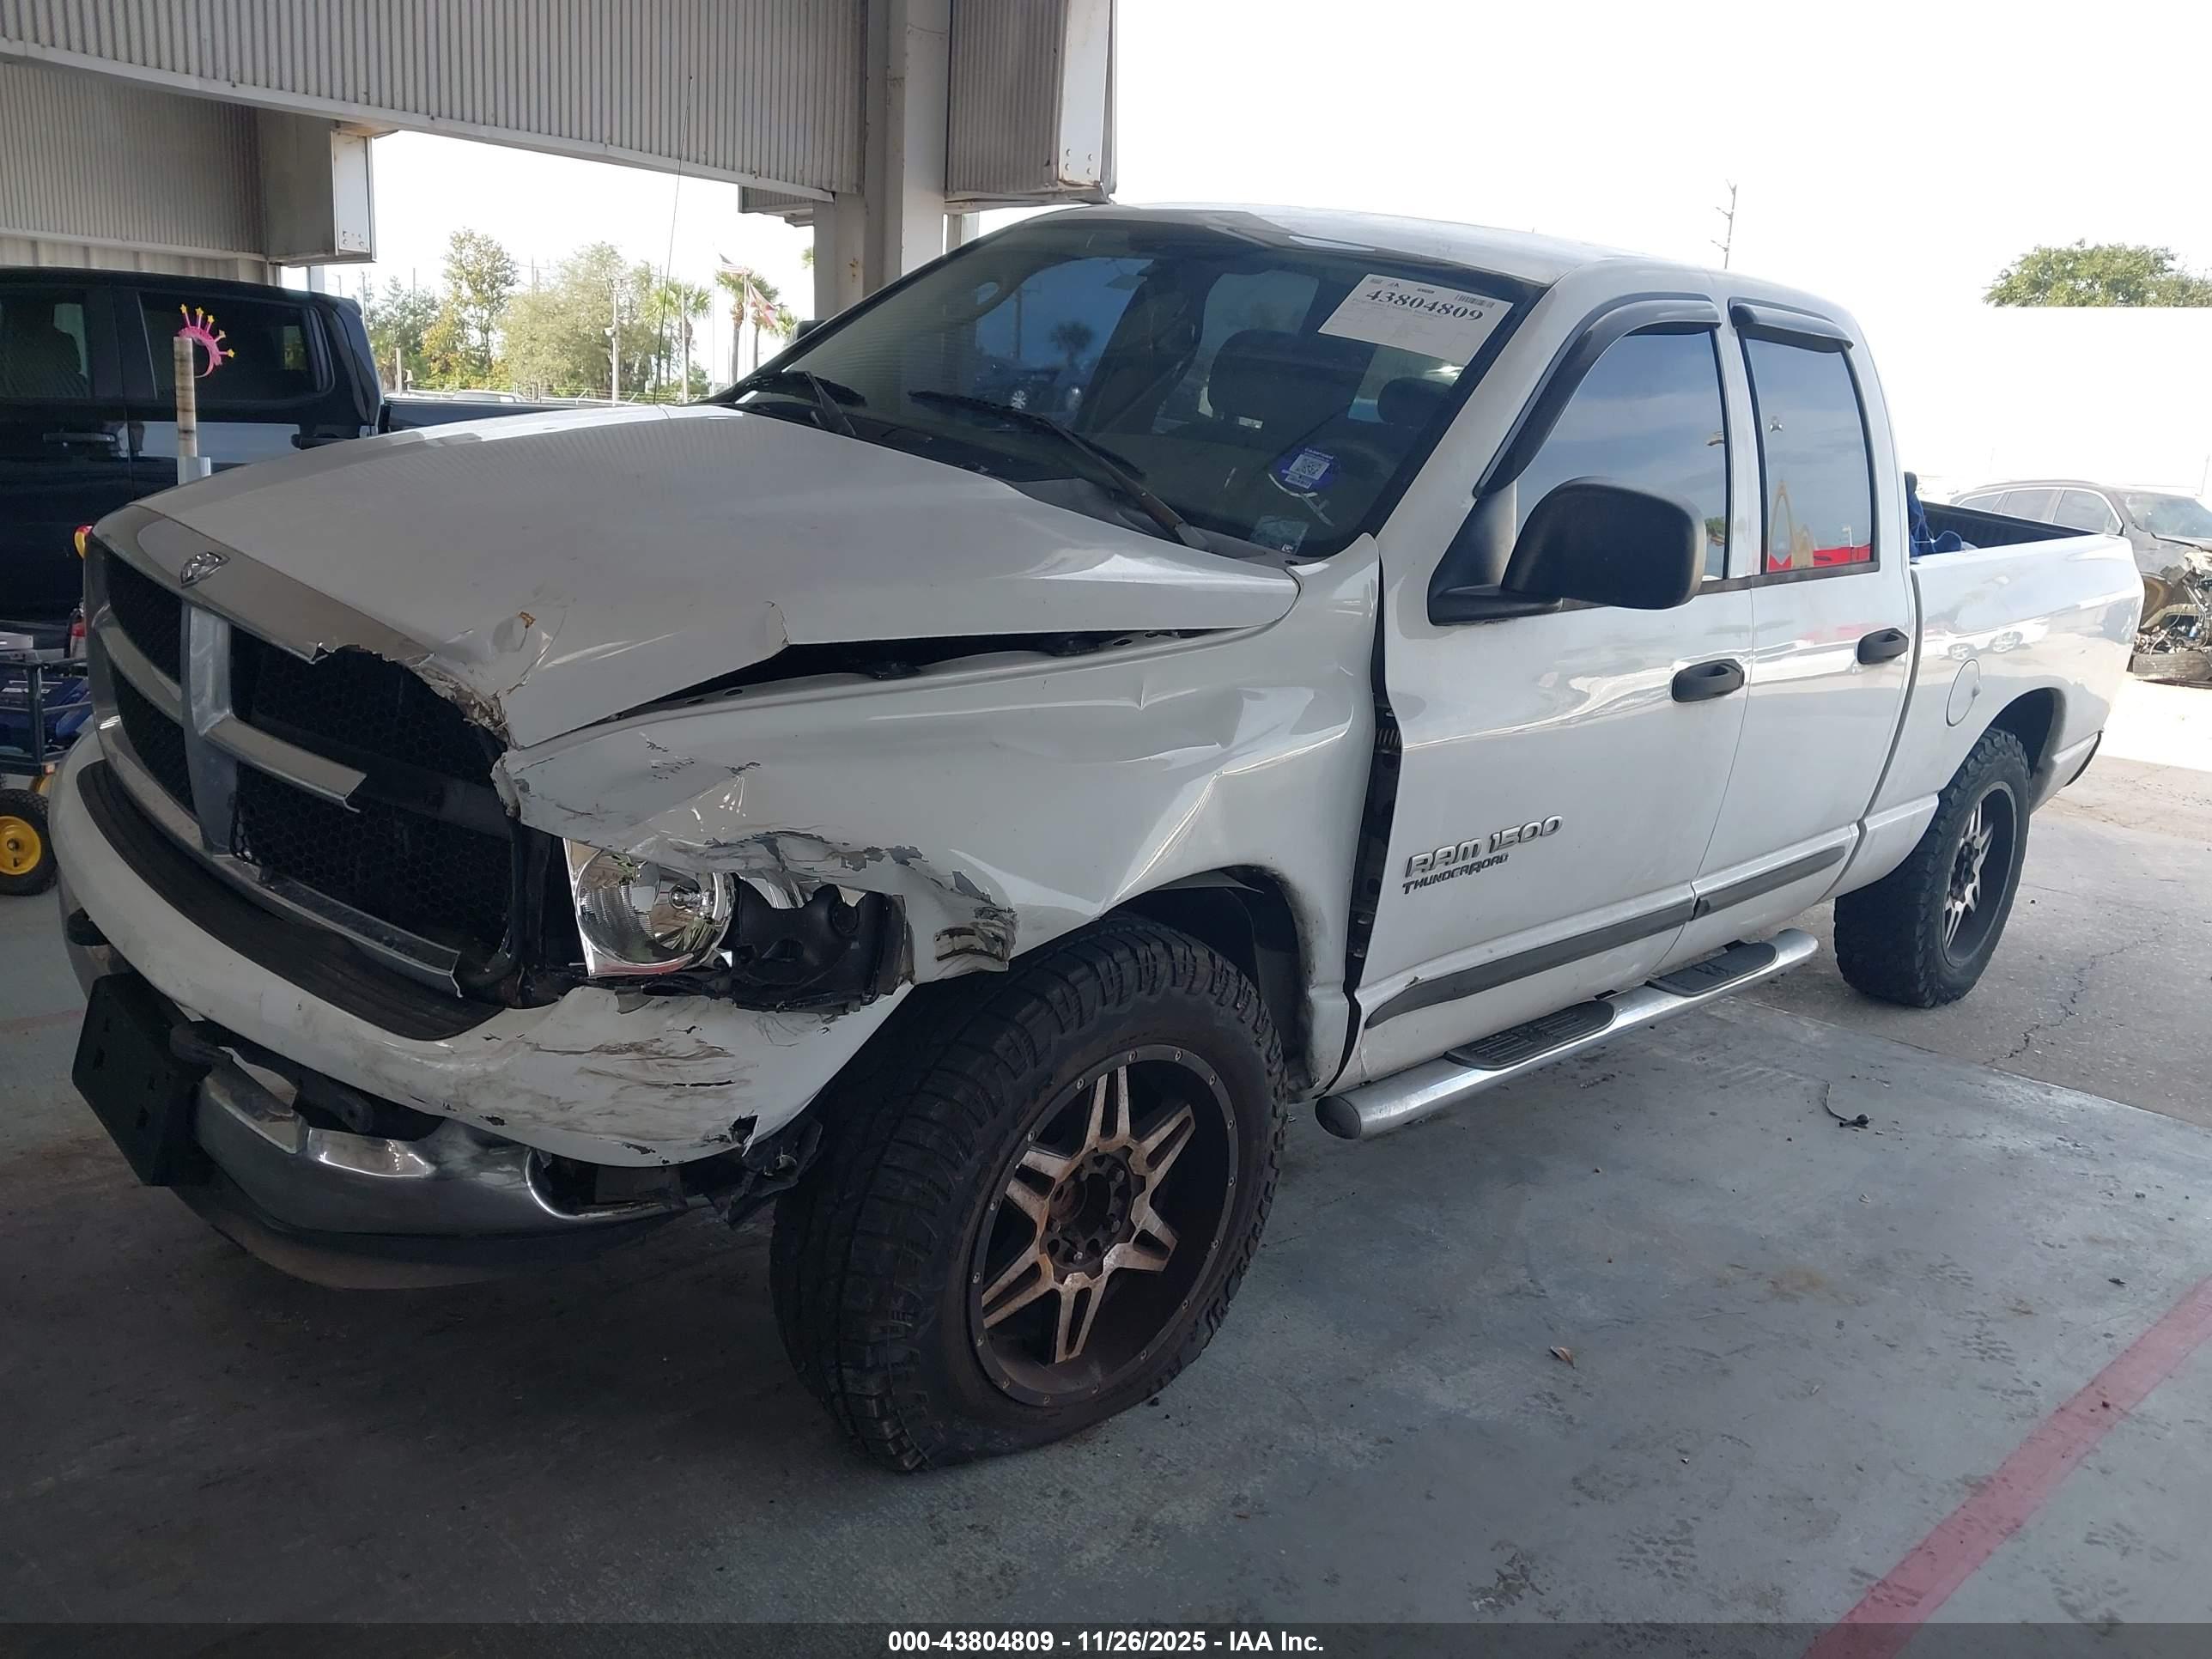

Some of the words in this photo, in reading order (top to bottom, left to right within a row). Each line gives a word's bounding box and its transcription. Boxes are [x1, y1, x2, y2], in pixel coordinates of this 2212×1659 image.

[1365, 289, 1484, 321] 43804809
[1404, 837, 1483, 878] RAM
[1488, 814, 1564, 854] 1500
